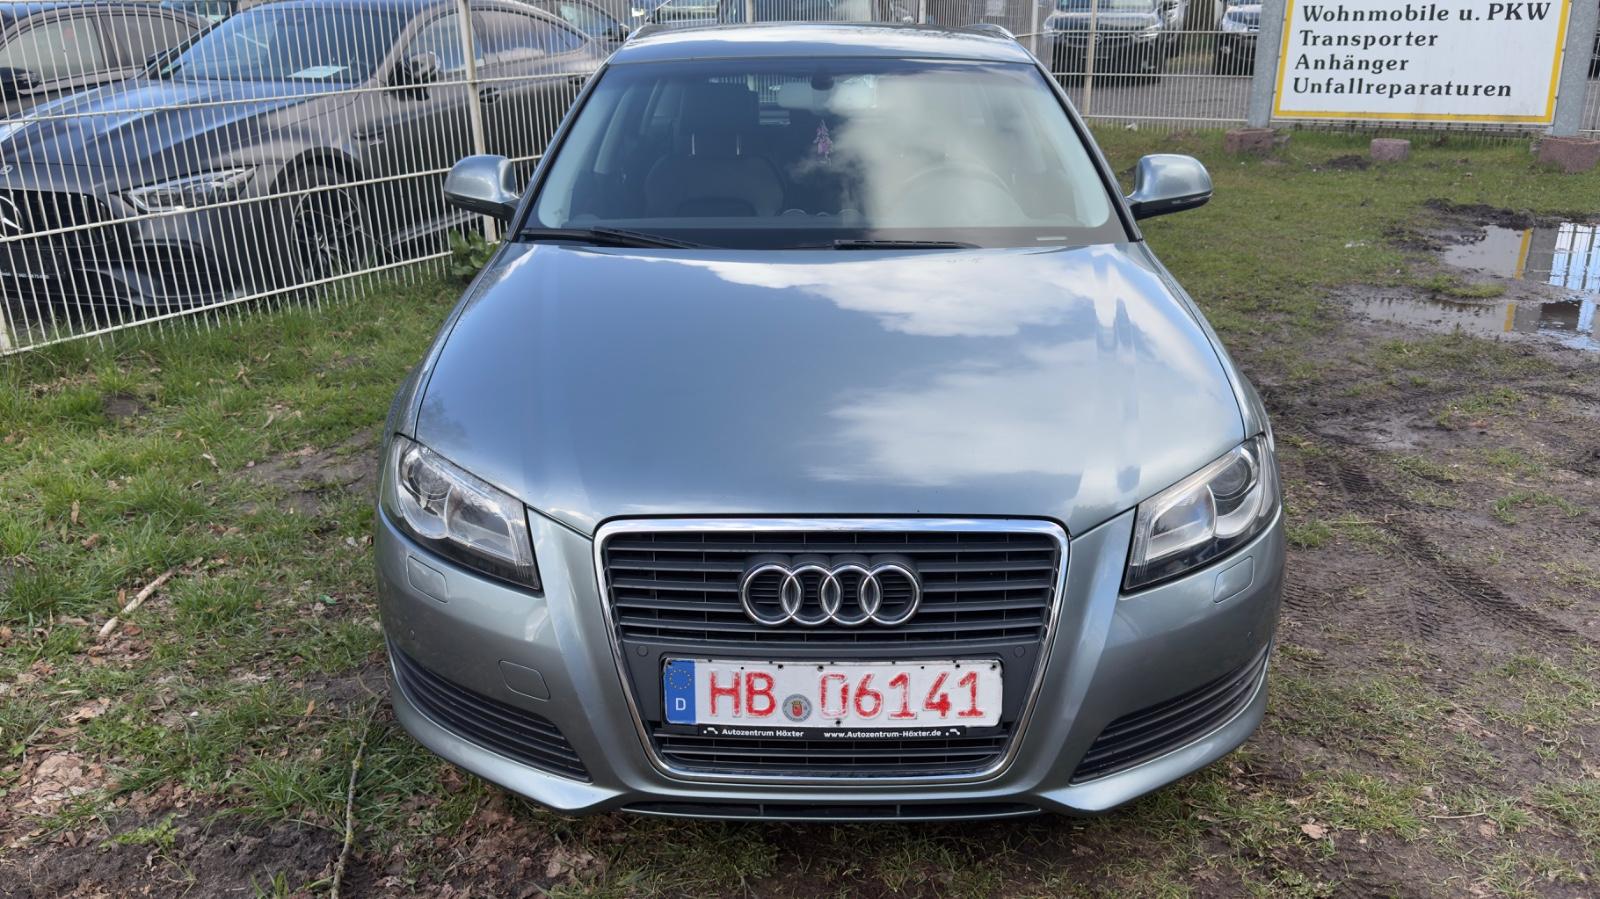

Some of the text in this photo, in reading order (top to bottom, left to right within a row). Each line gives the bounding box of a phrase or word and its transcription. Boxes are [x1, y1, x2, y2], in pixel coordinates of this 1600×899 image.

[1303, 2, 1551, 22] Wohnmobile u. PKW
[1300, 29, 1438, 50] Transporter
[1294, 53, 1409, 74] Anhänger
[1293, 77, 1512, 99] Unfallreparaturen
[675, 697, 687, 712] D
[708, 670, 777, 718] HB
[819, 670, 987, 720] 06141
[721, 728, 805, 738] Autozentrum Höxter
[823, 729, 942, 739] www.Autozentrum-Höxter.de
